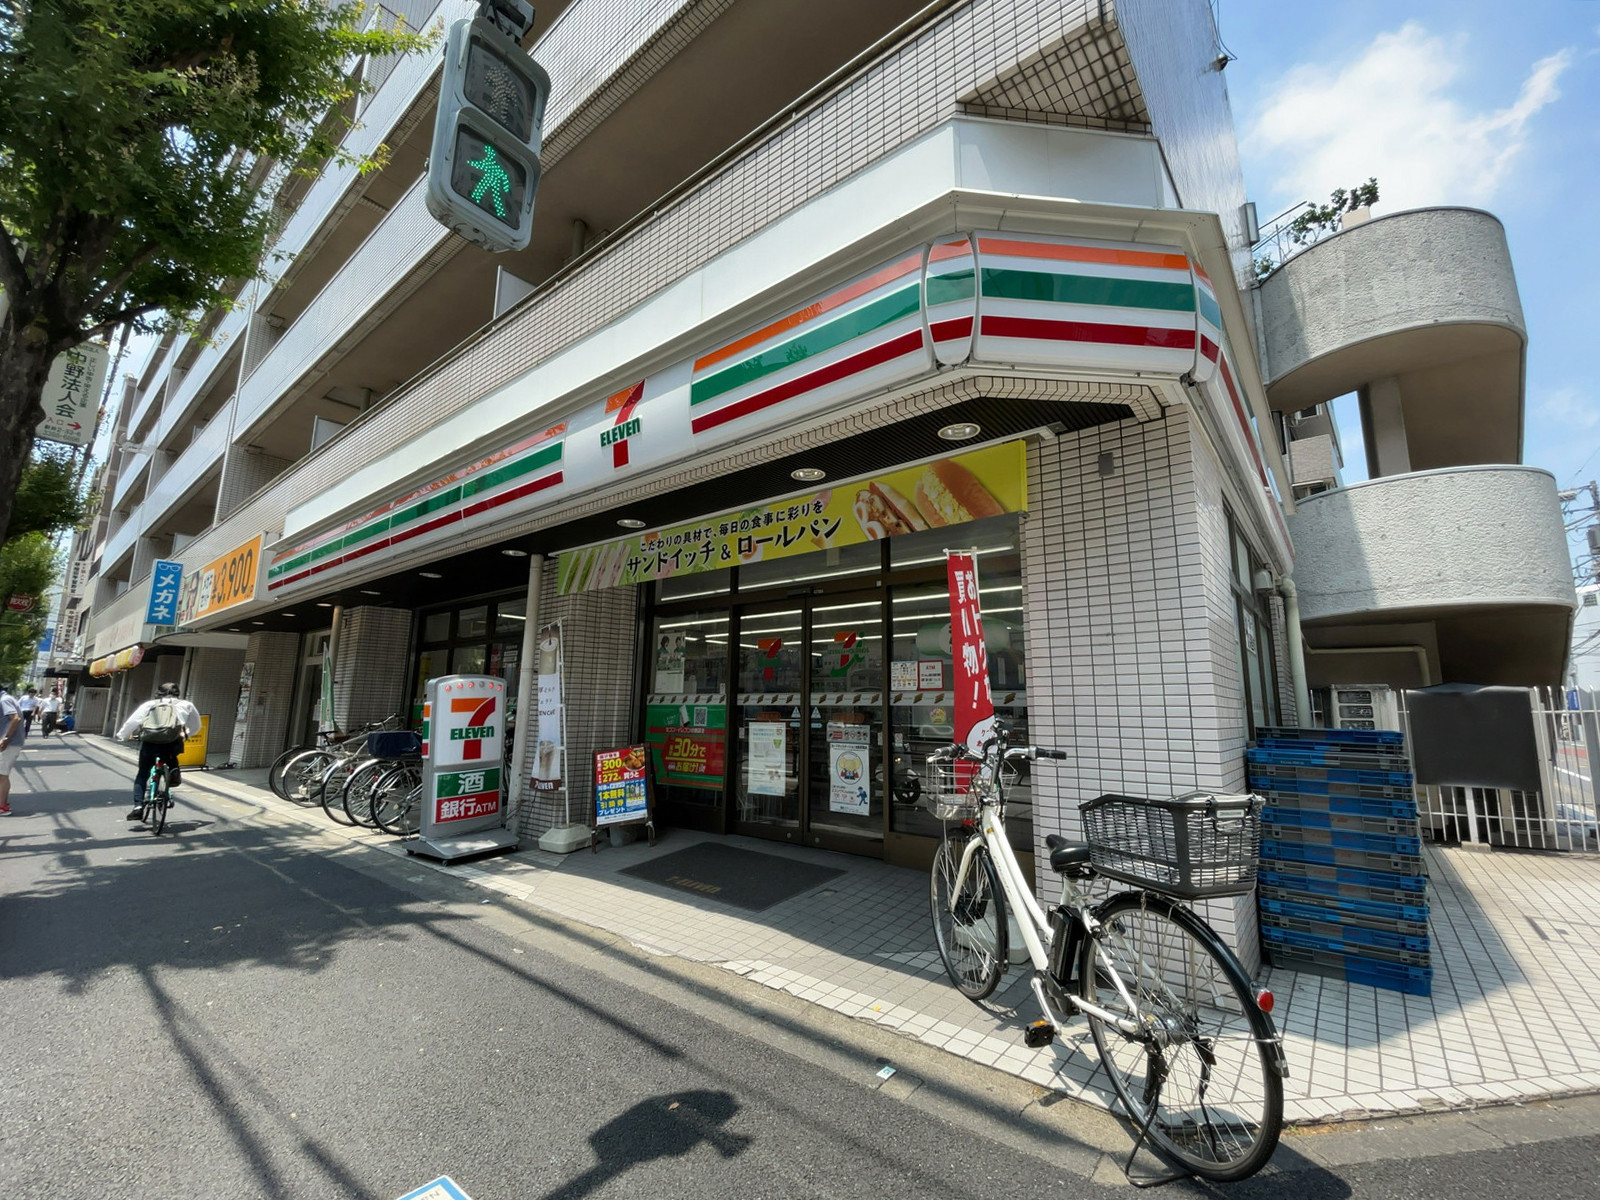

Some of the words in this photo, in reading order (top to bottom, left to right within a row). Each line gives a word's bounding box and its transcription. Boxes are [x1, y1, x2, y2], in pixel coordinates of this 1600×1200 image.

[640, 500, 823, 553] こだわりの具材で、毎日の食事に彩りを
[152, 573, 176, 620] メガネ
[457, 771, 486, 795] 酒
